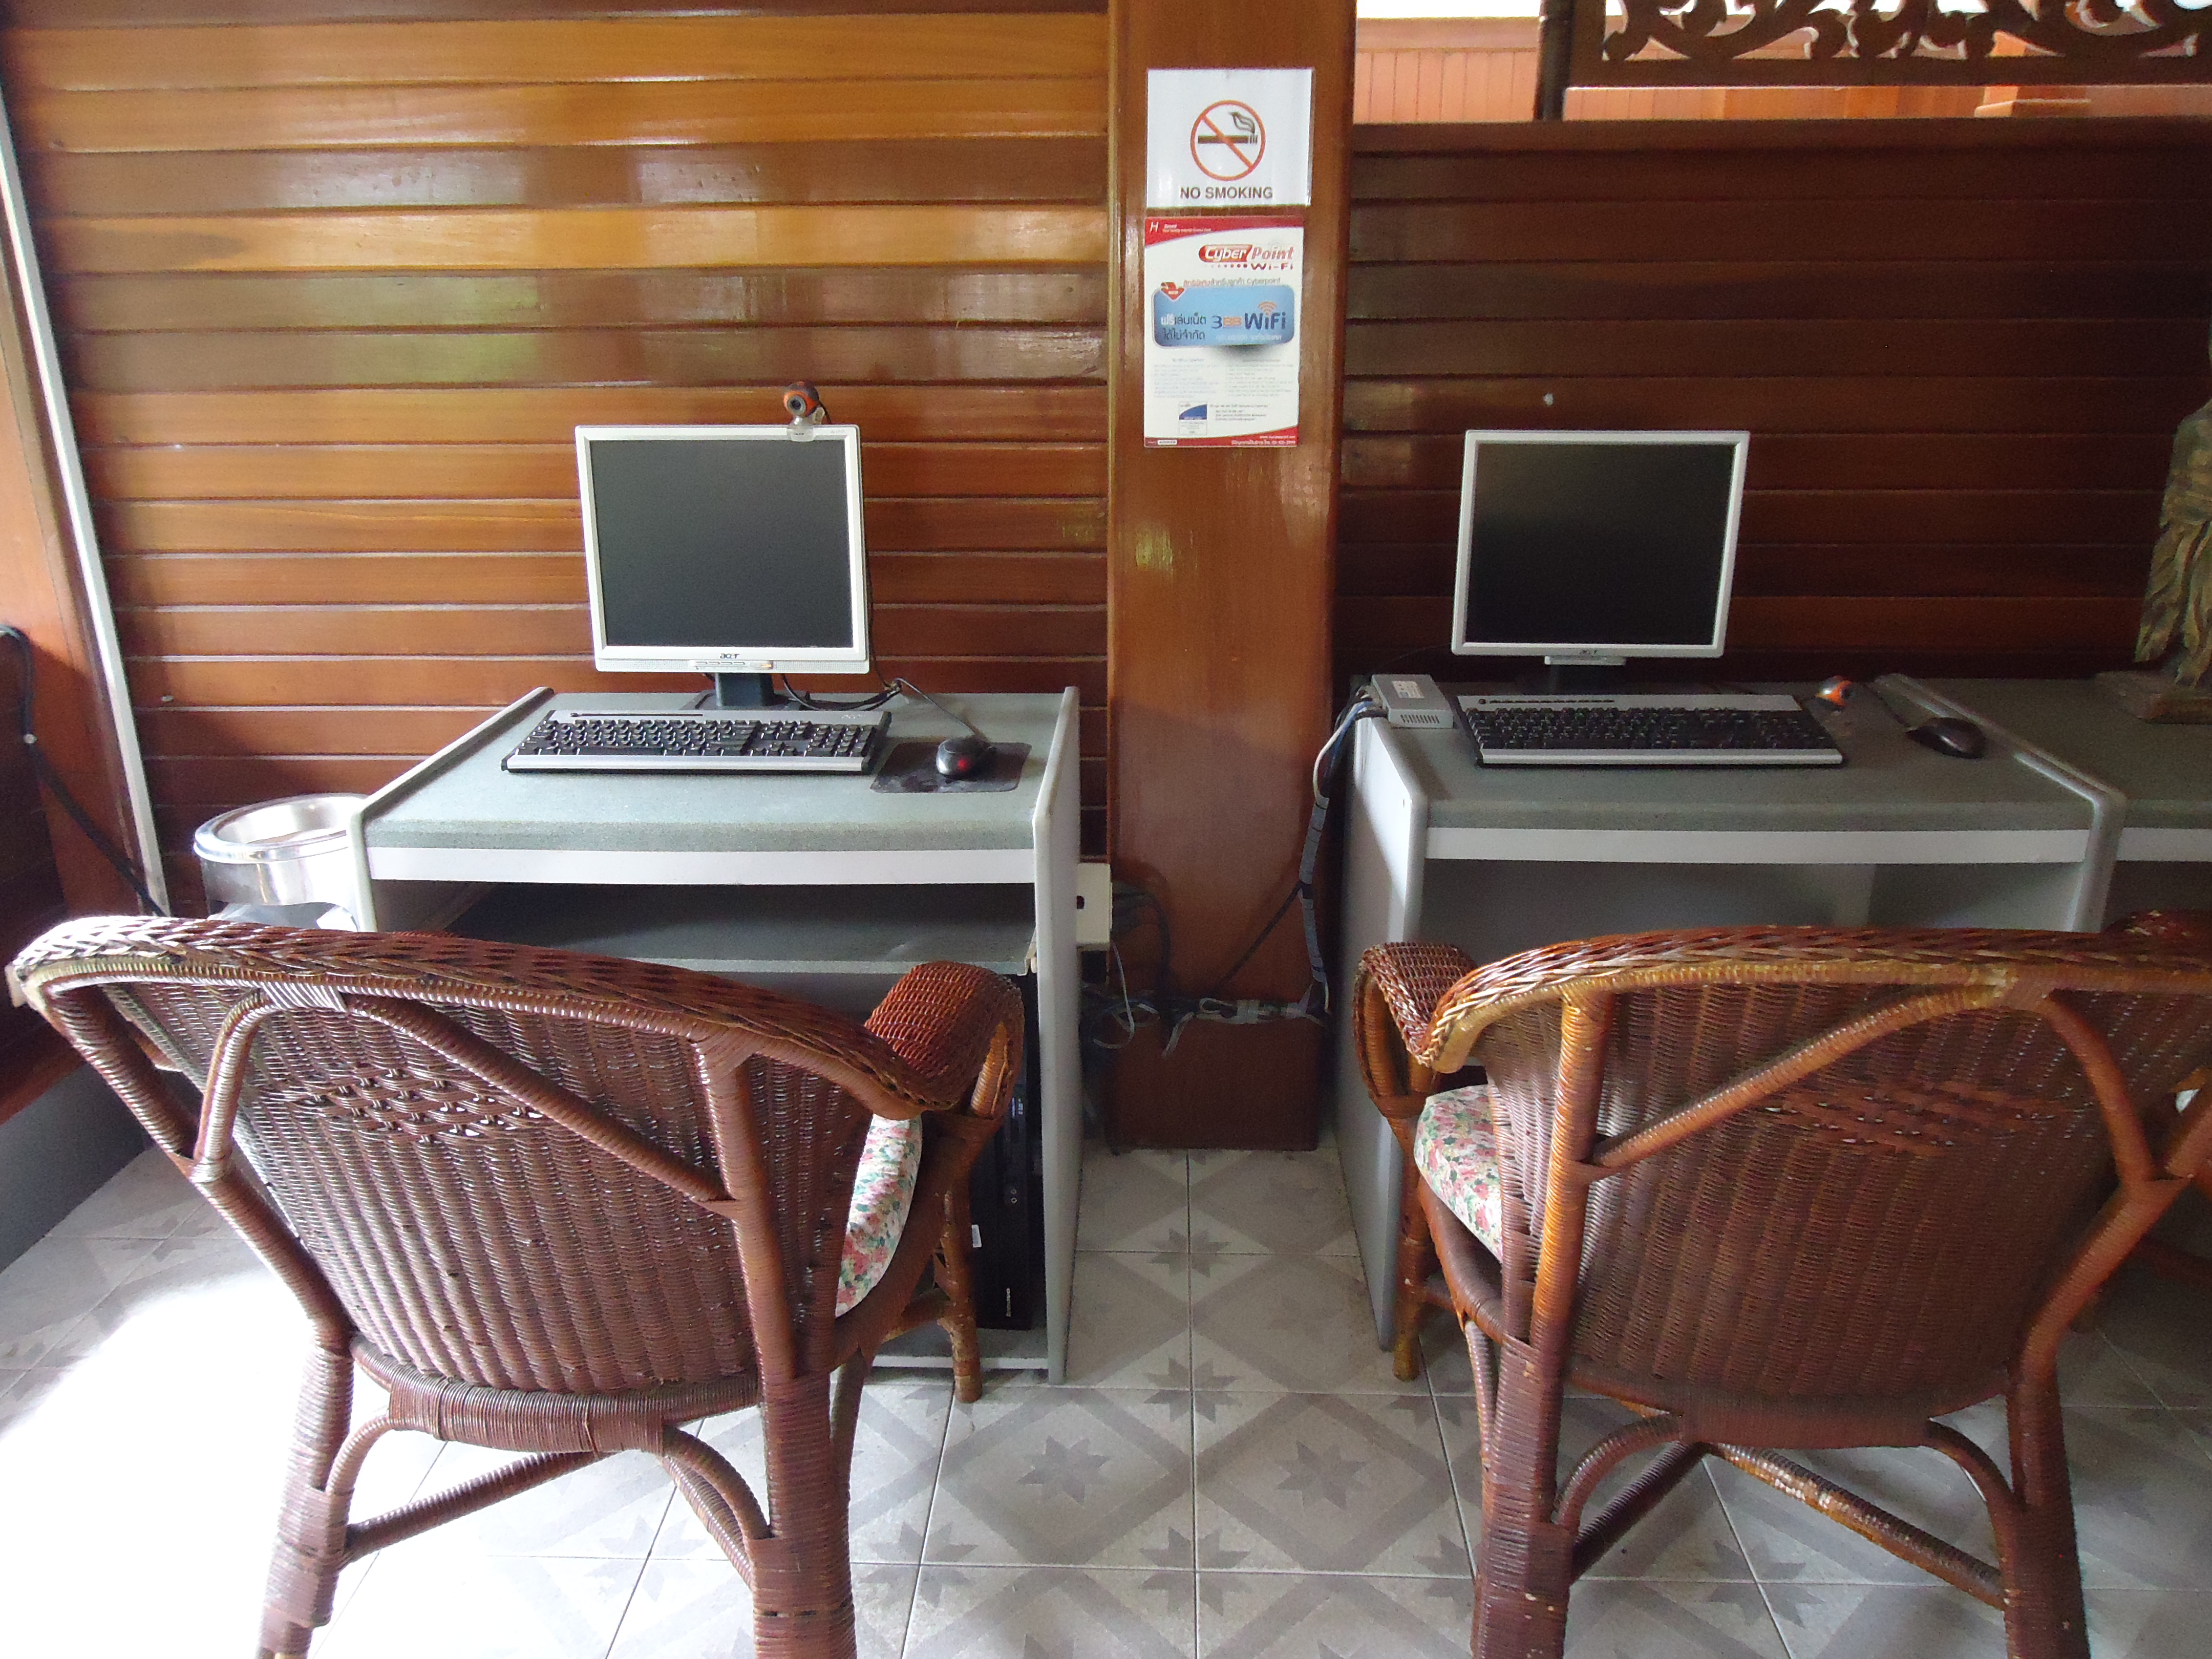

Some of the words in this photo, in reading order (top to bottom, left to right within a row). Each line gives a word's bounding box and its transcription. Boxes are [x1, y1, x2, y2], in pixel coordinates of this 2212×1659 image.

[1180, 187, 1201, 199] NO
[1205, 186, 1273, 199] SMOKING
[1251, 246, 1294, 260] Point
[1244, 311, 1286, 330] WiFi
